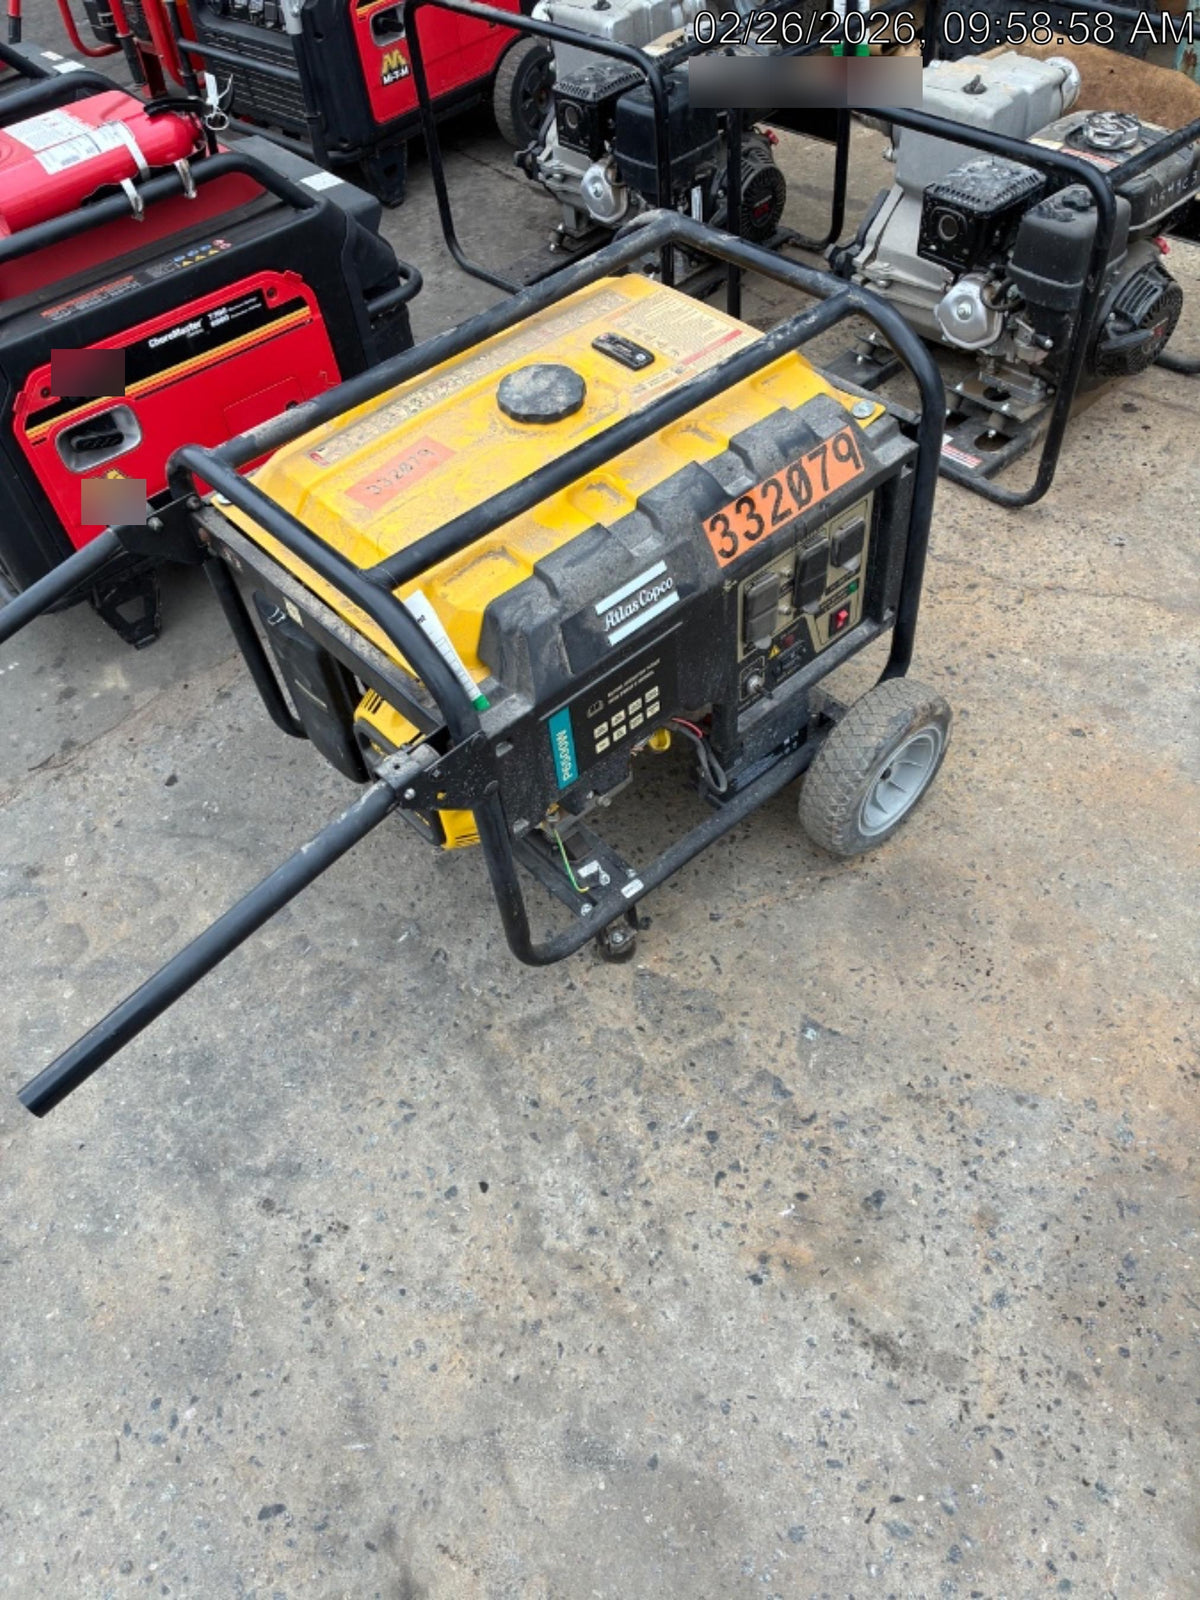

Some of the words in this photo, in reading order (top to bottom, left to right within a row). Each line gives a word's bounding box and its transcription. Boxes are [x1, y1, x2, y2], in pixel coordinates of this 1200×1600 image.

[709, 432, 862, 559] 332079
[603, 600, 640, 632] Atlas
[639, 576, 674, 607] Copco
